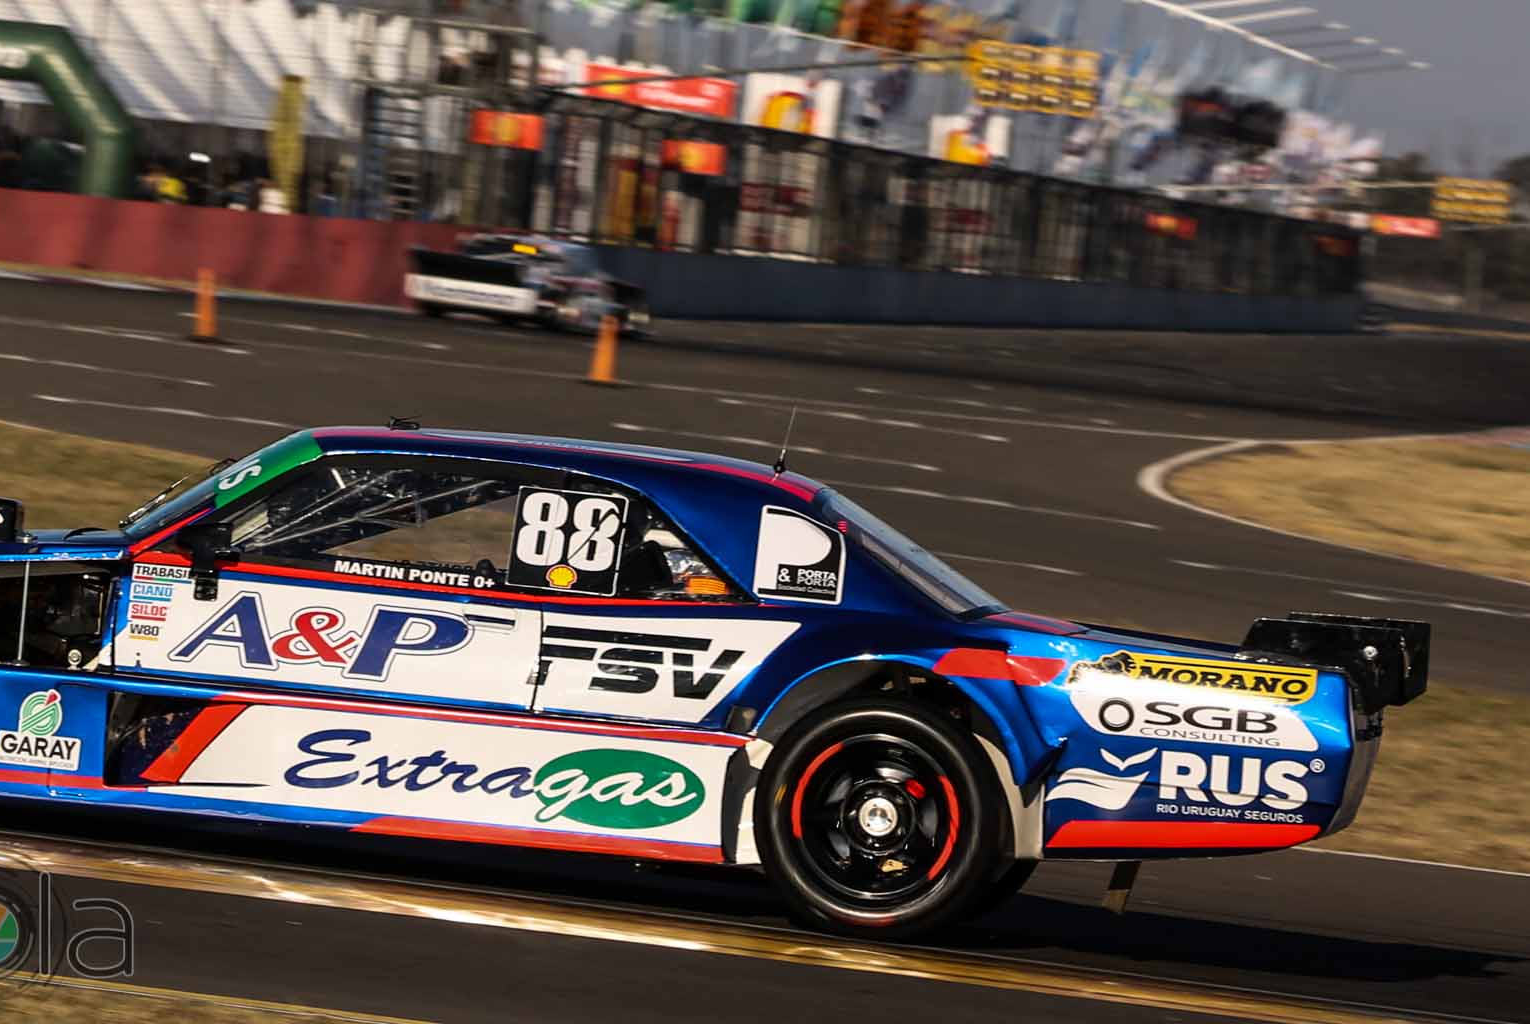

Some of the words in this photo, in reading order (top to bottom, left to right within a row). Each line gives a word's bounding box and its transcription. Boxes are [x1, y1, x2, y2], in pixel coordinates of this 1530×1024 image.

[516, 492, 621, 572] 88
[333, 560, 407, 581] MARTIN
[408, 568, 470, 588] PONTE
[796, 576, 836, 588] PORTA
[797, 568, 837, 581] PORTA
[133, 584, 173, 598] CIANO
[131, 603, 167, 617] SILOC
[130, 623, 160, 636] W80
[170, 593, 472, 679] A&P
[1139, 665, 1309, 696] MORANO
[1143, 701, 1278, 735] SGB
[0, 733, 77, 761] GARAY
[1139, 726, 1281, 747] CONSULTING
[284, 728, 699, 823] Extragas
[1156, 803, 1179, 814] RIO
[1181, 805, 1241, 819] URUGUAY
[1244, 810, 1305, 824] SEGUROS
